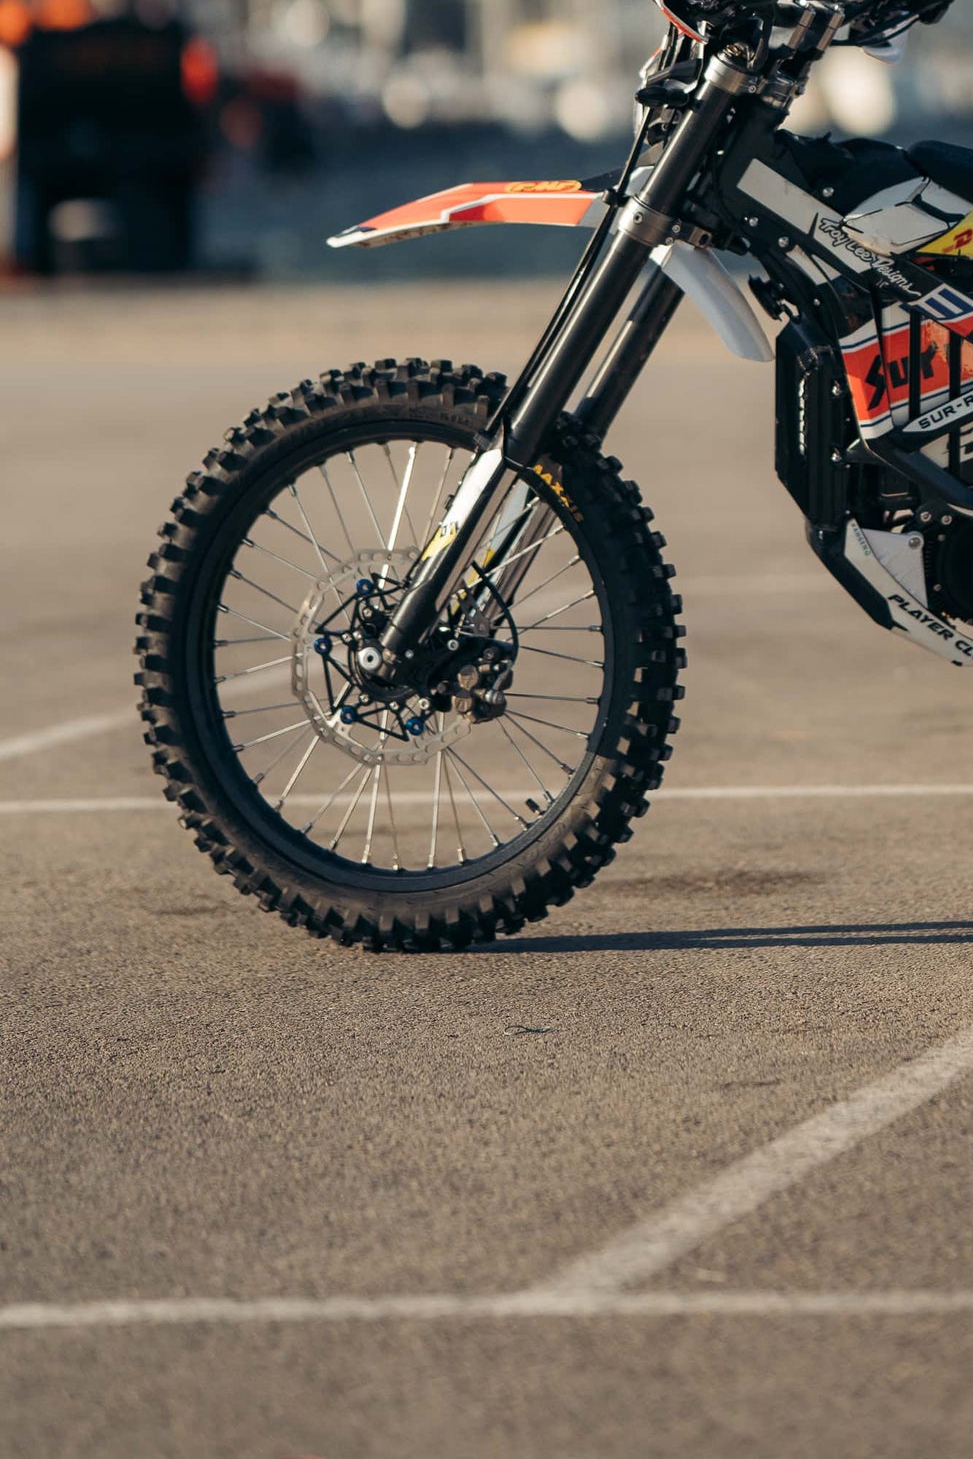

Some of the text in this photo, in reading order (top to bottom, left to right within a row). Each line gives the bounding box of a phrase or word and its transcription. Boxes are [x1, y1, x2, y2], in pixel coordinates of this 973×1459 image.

[819, 218, 922, 297] Troy Lee Designs
[888, 594, 954, 641] PLAYER
